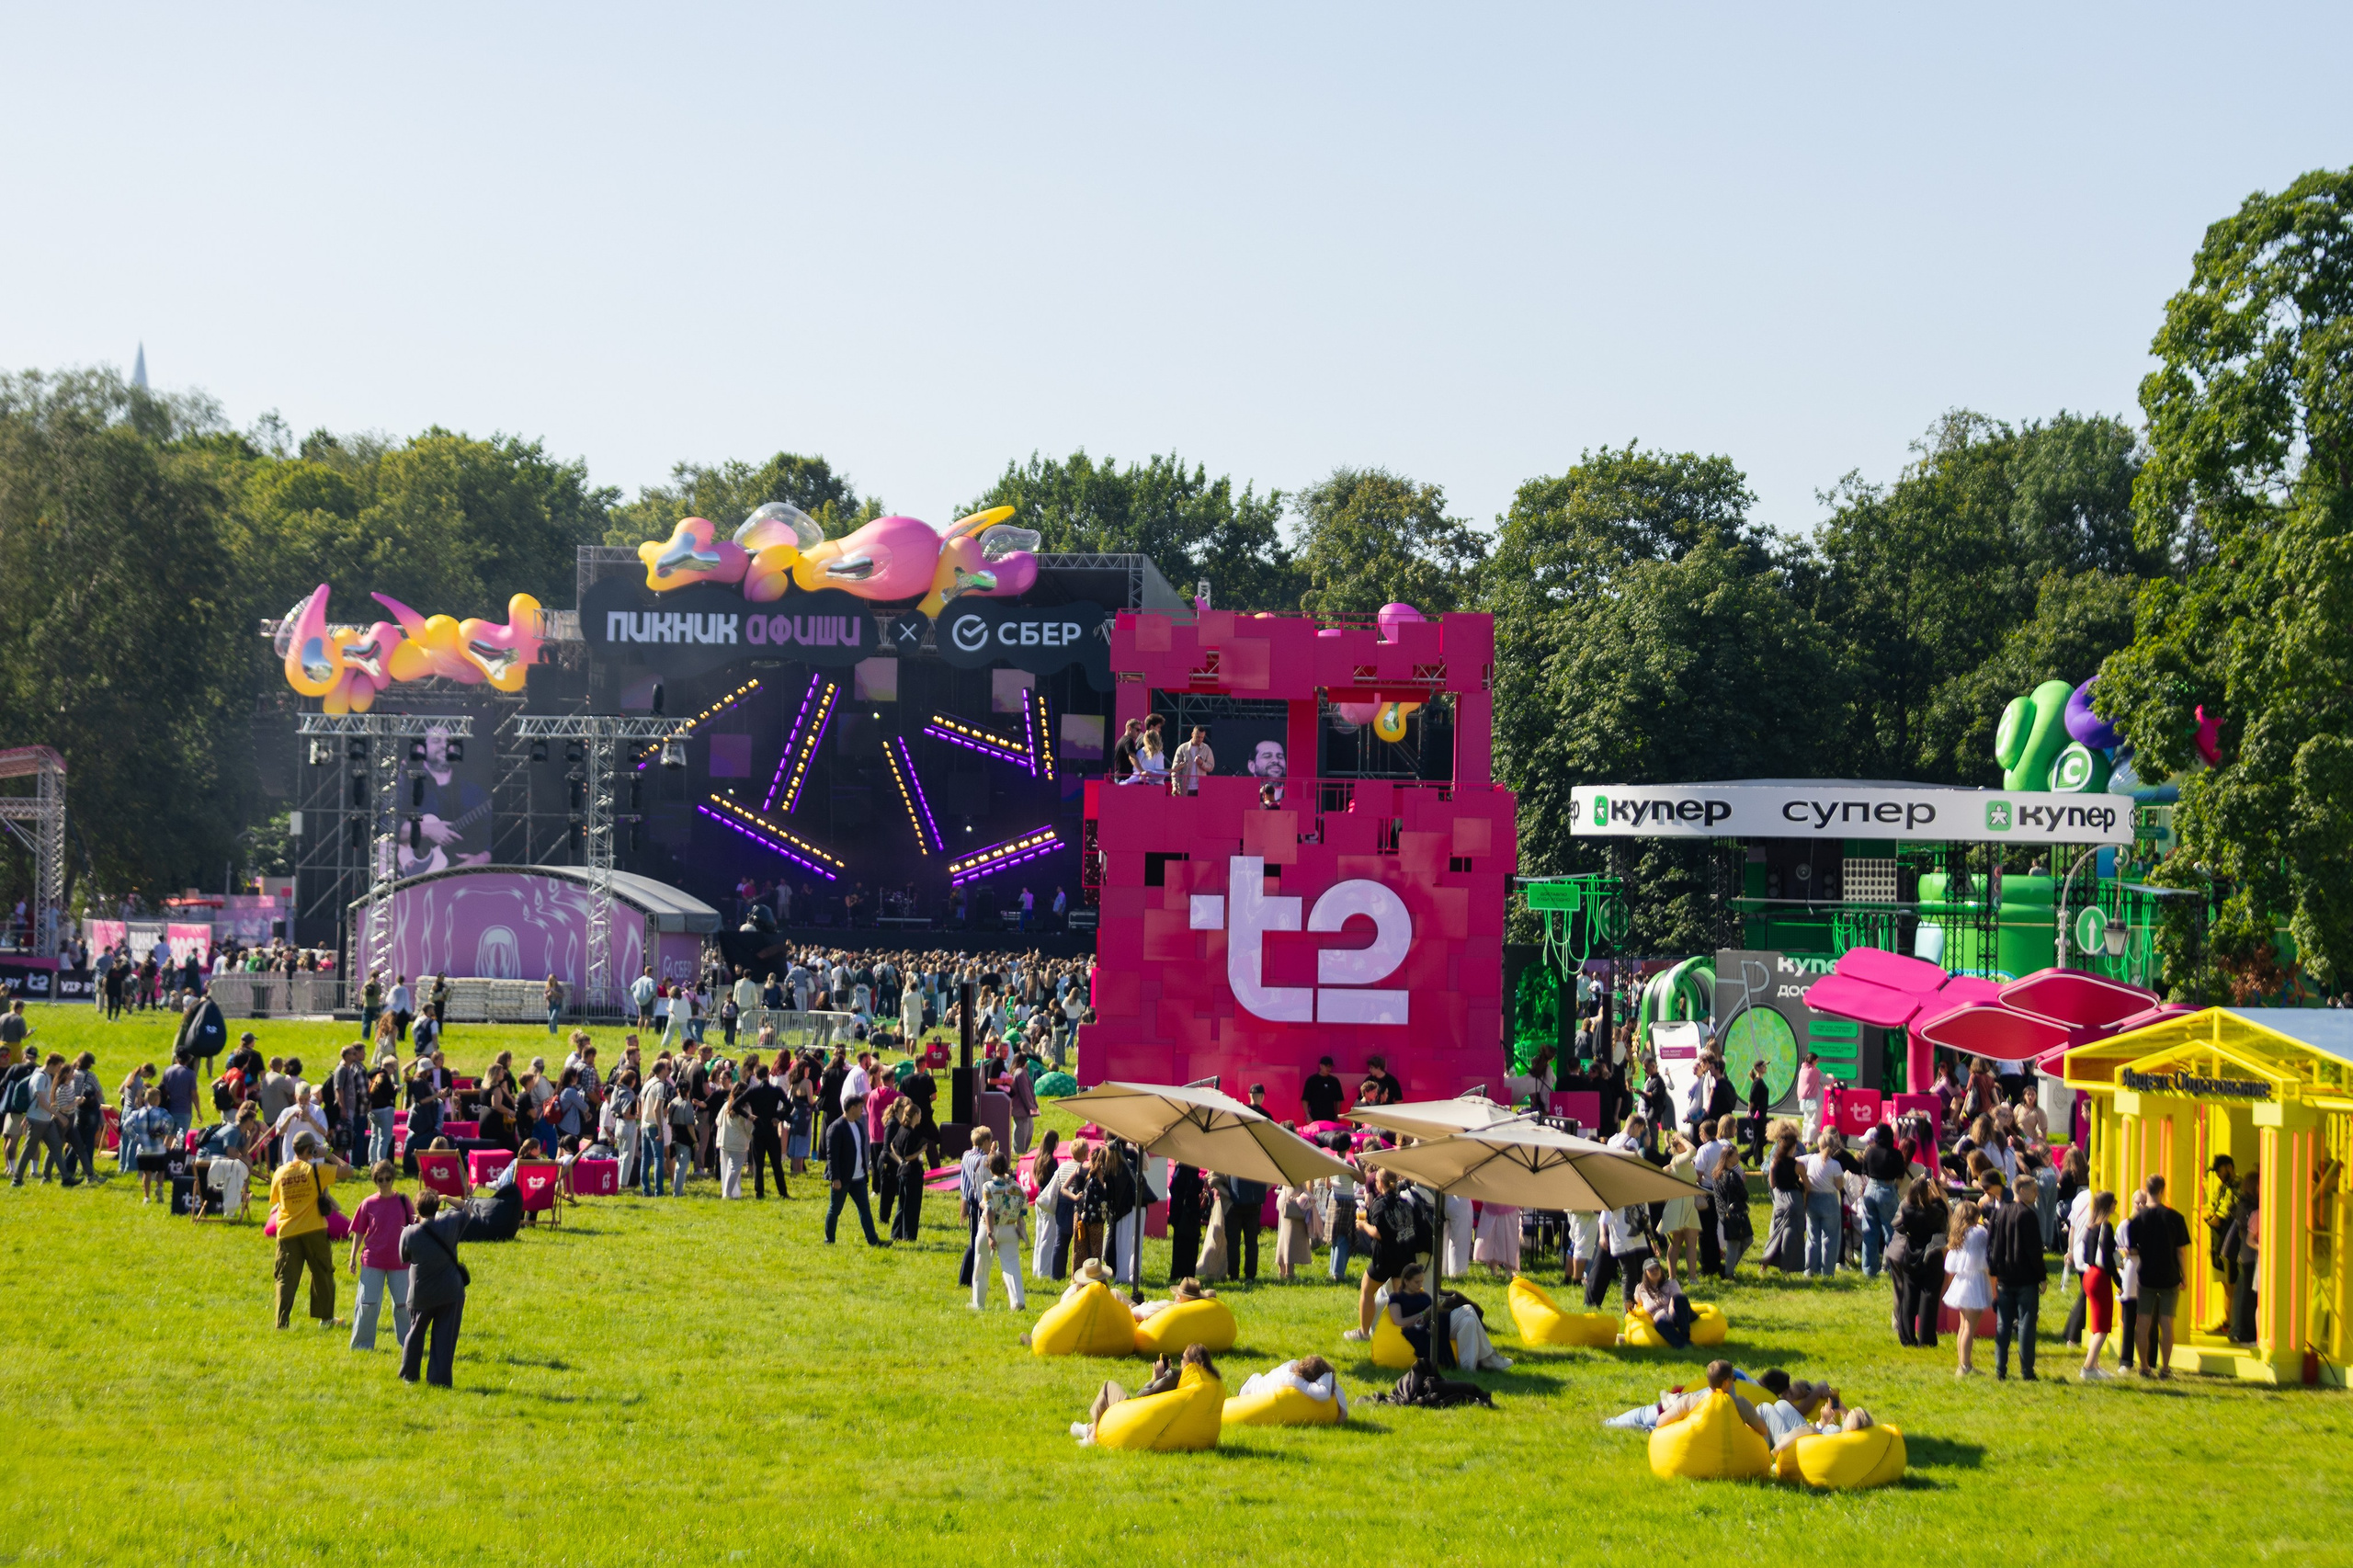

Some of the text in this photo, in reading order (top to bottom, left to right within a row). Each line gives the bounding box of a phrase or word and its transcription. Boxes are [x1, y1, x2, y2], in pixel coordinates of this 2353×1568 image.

[607, 610, 738, 644] ПИКНИК
[997, 621, 1082, 646] СБЕР
[1611, 800, 1733, 827] купер
[1781, 800, 1937, 830] супер
[2018, 805, 2116, 833] купер
[1189, 856, 1413, 1025] t2
[1850, 1102, 1872, 1122] t2
[280, 1174, 308, 1187] DEUS
[430, 1165, 449, 1179] t2
